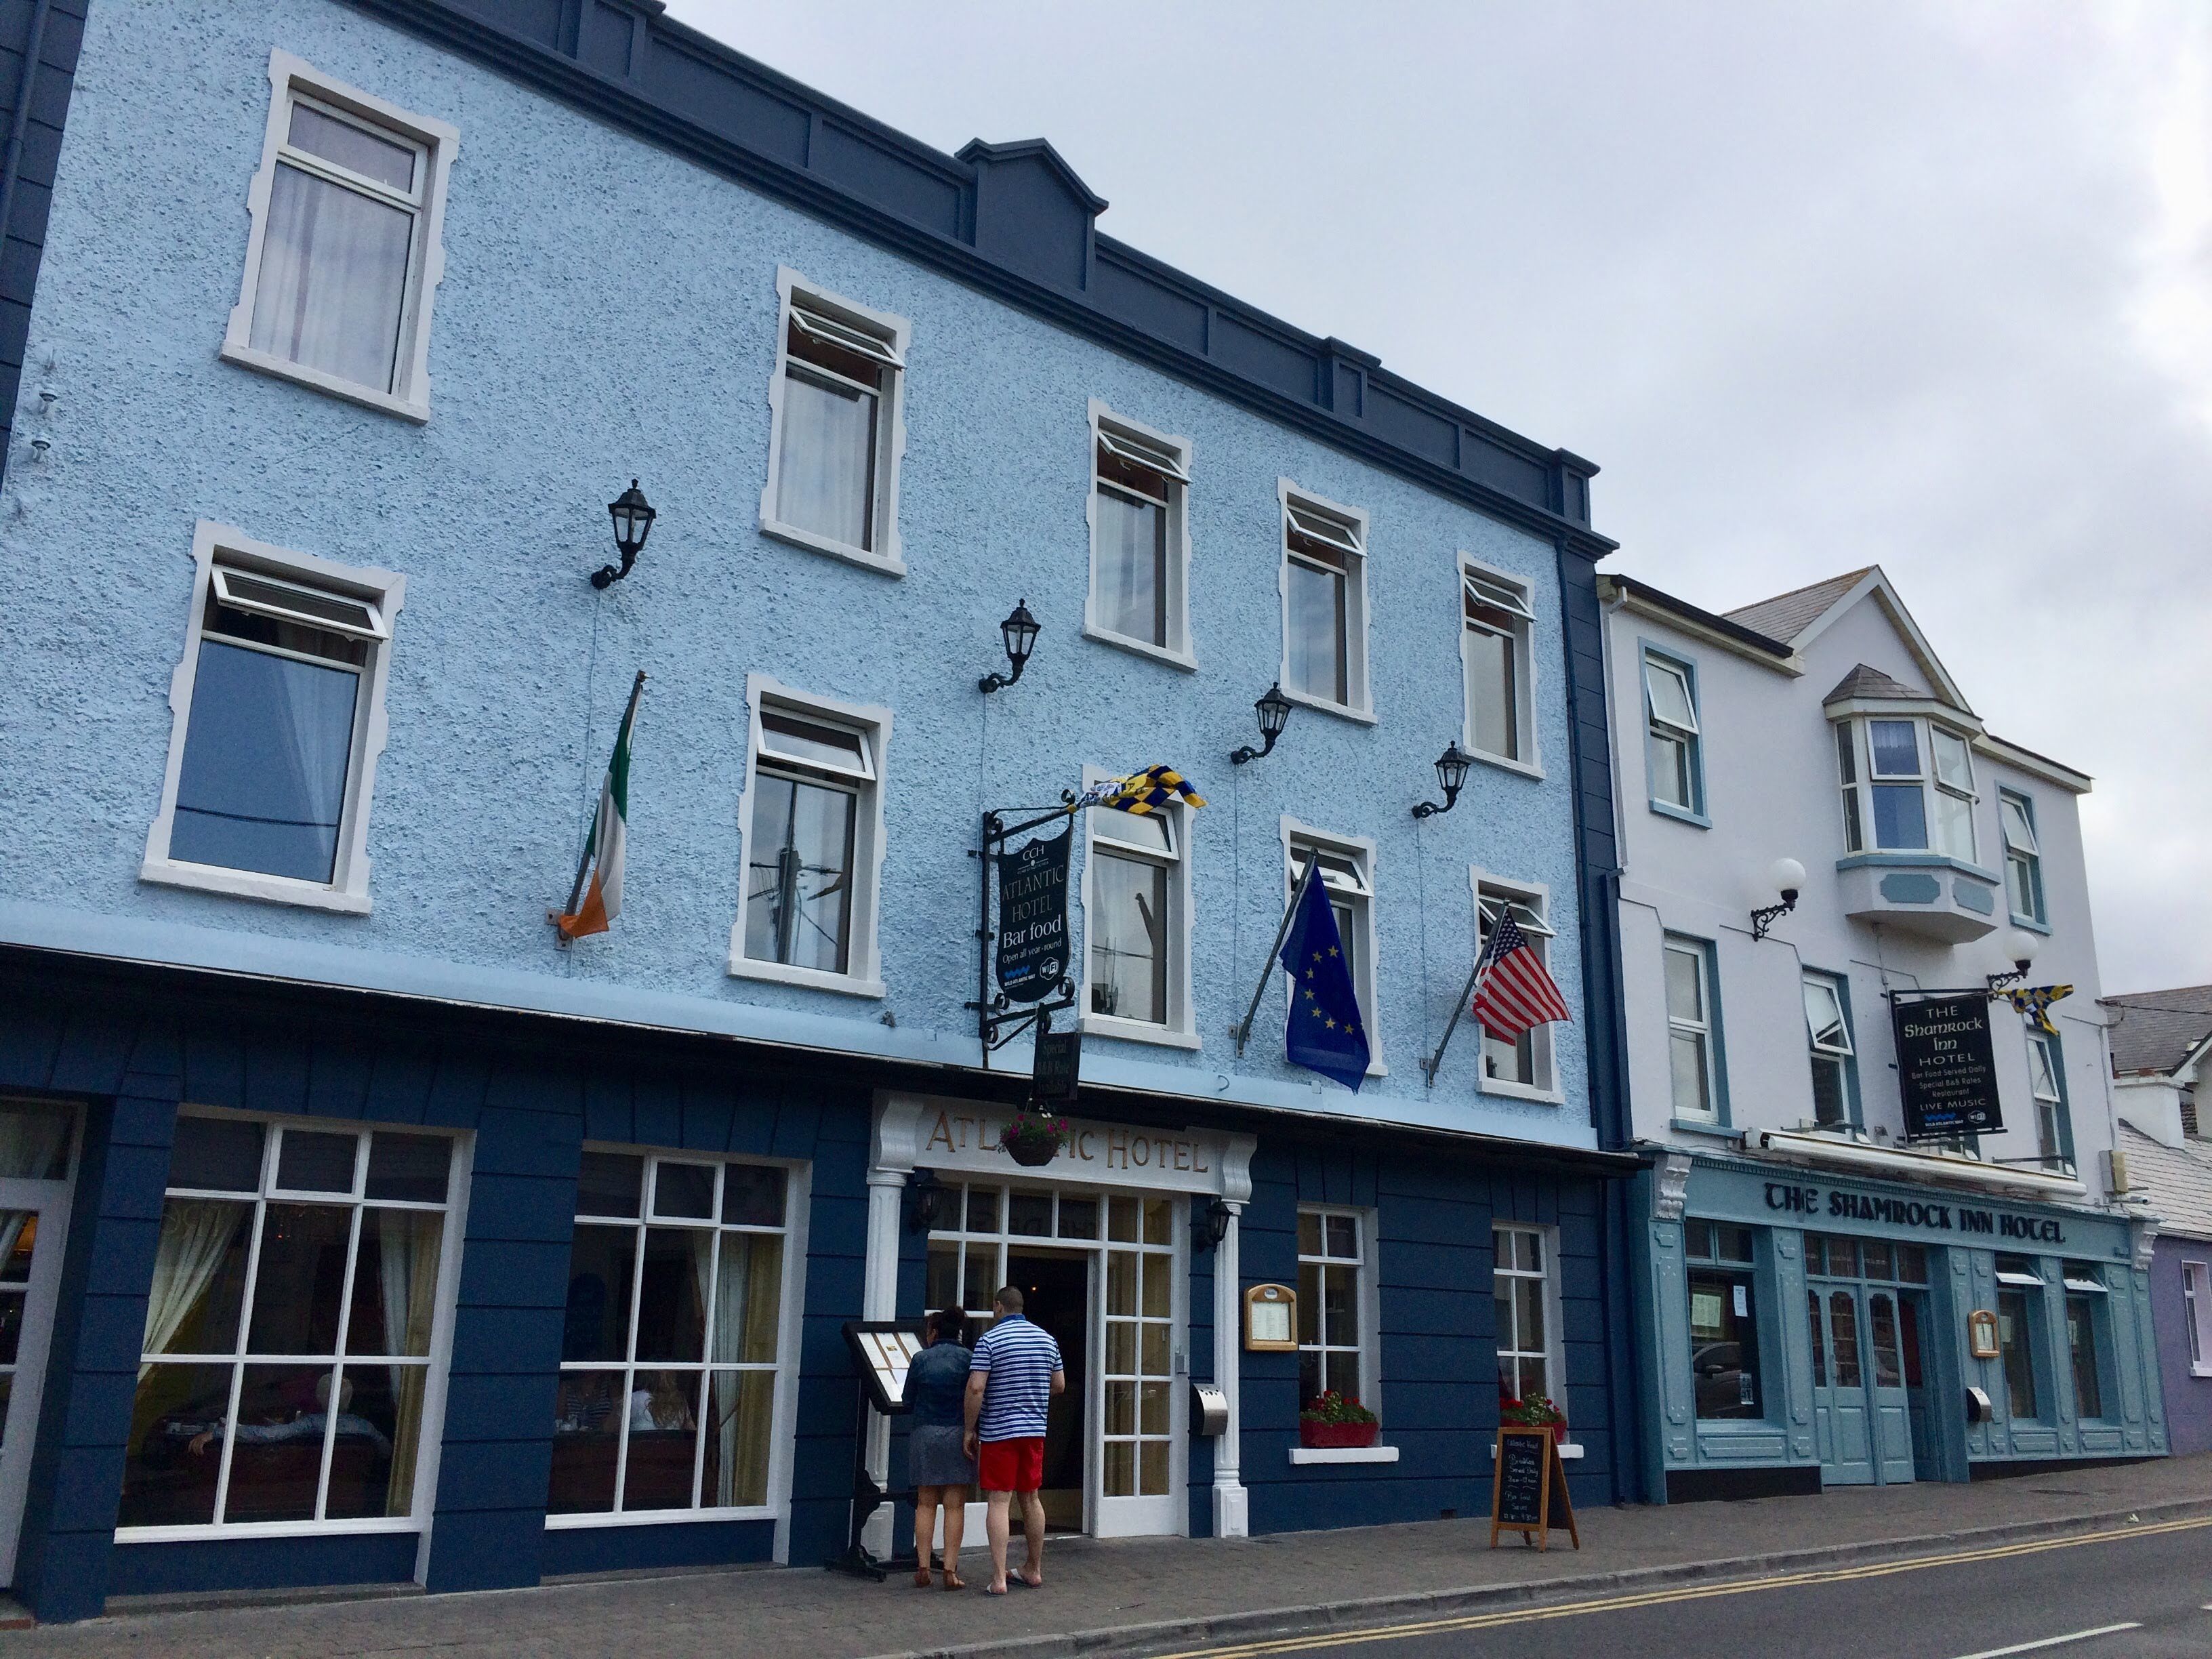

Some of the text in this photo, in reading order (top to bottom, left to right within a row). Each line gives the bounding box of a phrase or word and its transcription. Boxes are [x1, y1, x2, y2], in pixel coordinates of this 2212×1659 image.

[1023, 845, 1044, 861] CCH
[1002, 864, 1064, 901] ATLANTIC
[1012, 895, 1052, 923] HOTEL
[1004, 914, 1061, 949] Bar food
[1003, 953, 1019, 964] Open
[1019, 948, 1027, 958] all
[1926, 1006, 1959, 1019] THE
[1933, 1037, 1957, 1051] Inn
[1919, 1052, 1975, 1067] HOTEL
[1925, 1069, 1942, 1078] Food
[1943, 1067, 1967, 1076] Served
[1968, 1065, 1986, 1073] Daily
[1919, 1080, 1944, 1090] Special
[1961, 1077, 1982, 1085] Rates
[1932, 1088, 1970, 1098] Restaurant
[1919, 1098, 1986, 1111] LIVE MUSIC
[926, 1111, 1209, 1174] ATLIC HOTEL
[1765, 1182, 2066, 1244] THE SHAMROCK INN HOTEL
